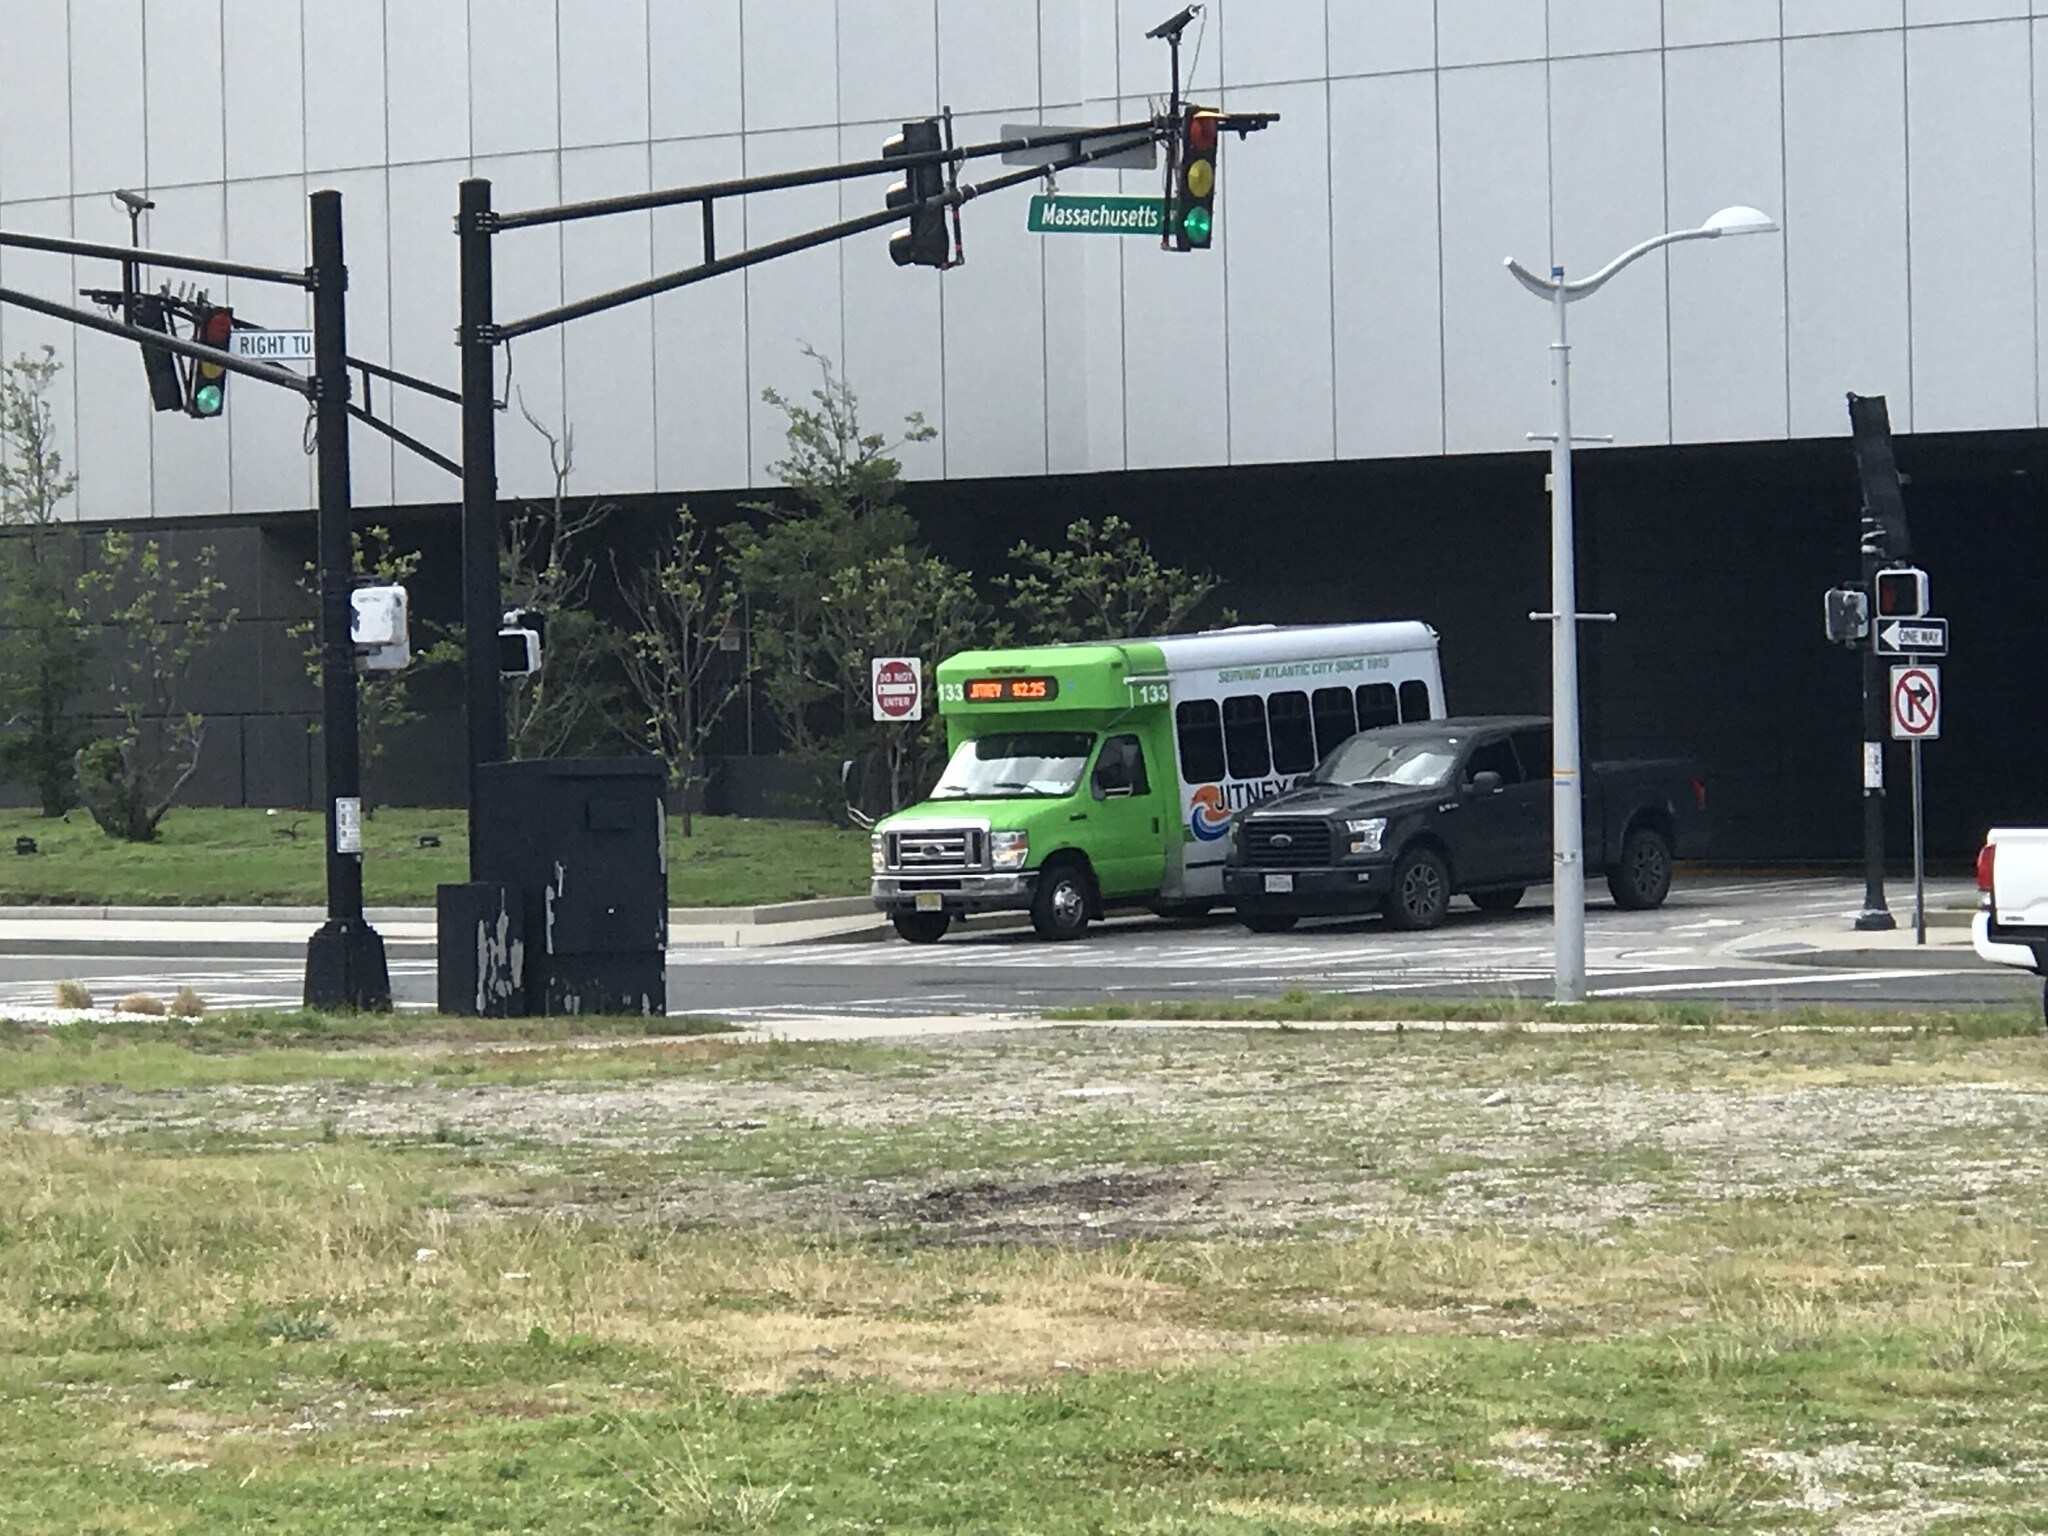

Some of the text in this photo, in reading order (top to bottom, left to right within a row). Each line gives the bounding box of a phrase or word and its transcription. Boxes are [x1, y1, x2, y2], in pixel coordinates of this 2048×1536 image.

[1042, 203, 1158, 227] Massachusetts
[240, 335, 286, 355] RIGHT
[1899, 629, 1939, 643] ONE WAY
[879, 672, 913, 683] DO NOT
[1218, 668, 1262, 684] SERVING
[1263, 663, 1310, 679] ATLANTIC
[1312, 661, 1334, 675] CITY
[1336, 659, 1364, 673] SINCE
[938, 683, 964, 701] 133
[1139, 684, 1169, 702] 133
[883, 697, 910, 707] ENTER
